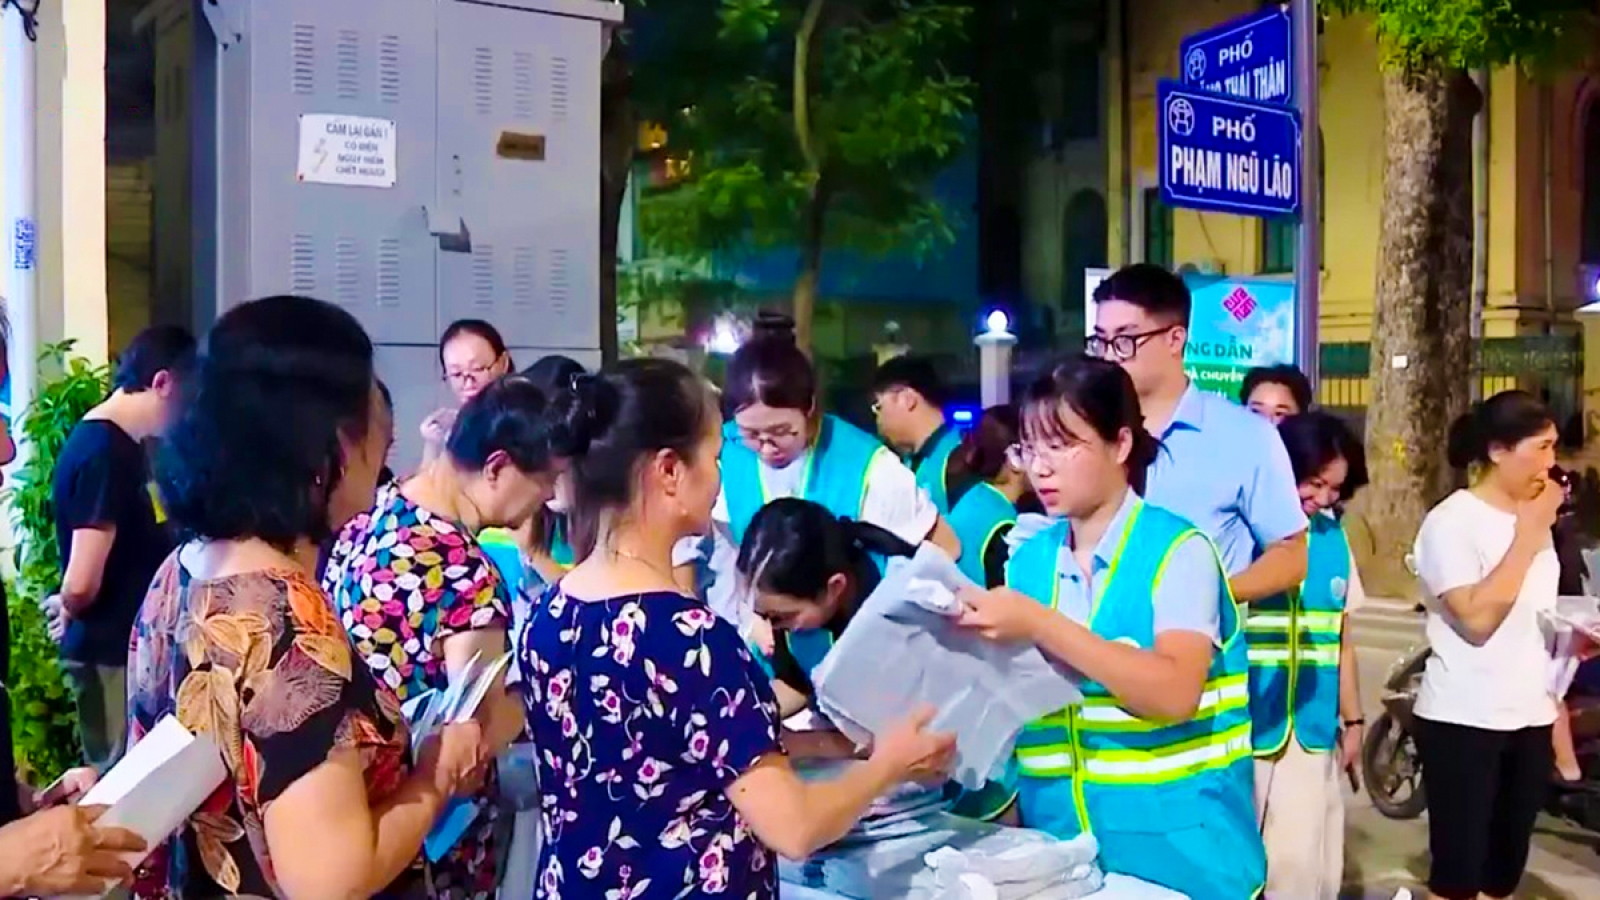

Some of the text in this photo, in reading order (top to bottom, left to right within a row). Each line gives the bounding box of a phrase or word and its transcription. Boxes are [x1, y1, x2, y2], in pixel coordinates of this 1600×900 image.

[1219, 31, 1253, 67] PHỐ
[1212, 113, 1256, 142] PHỐ
[1172, 144, 1292, 199] PHẠM NGŨ LÃO
